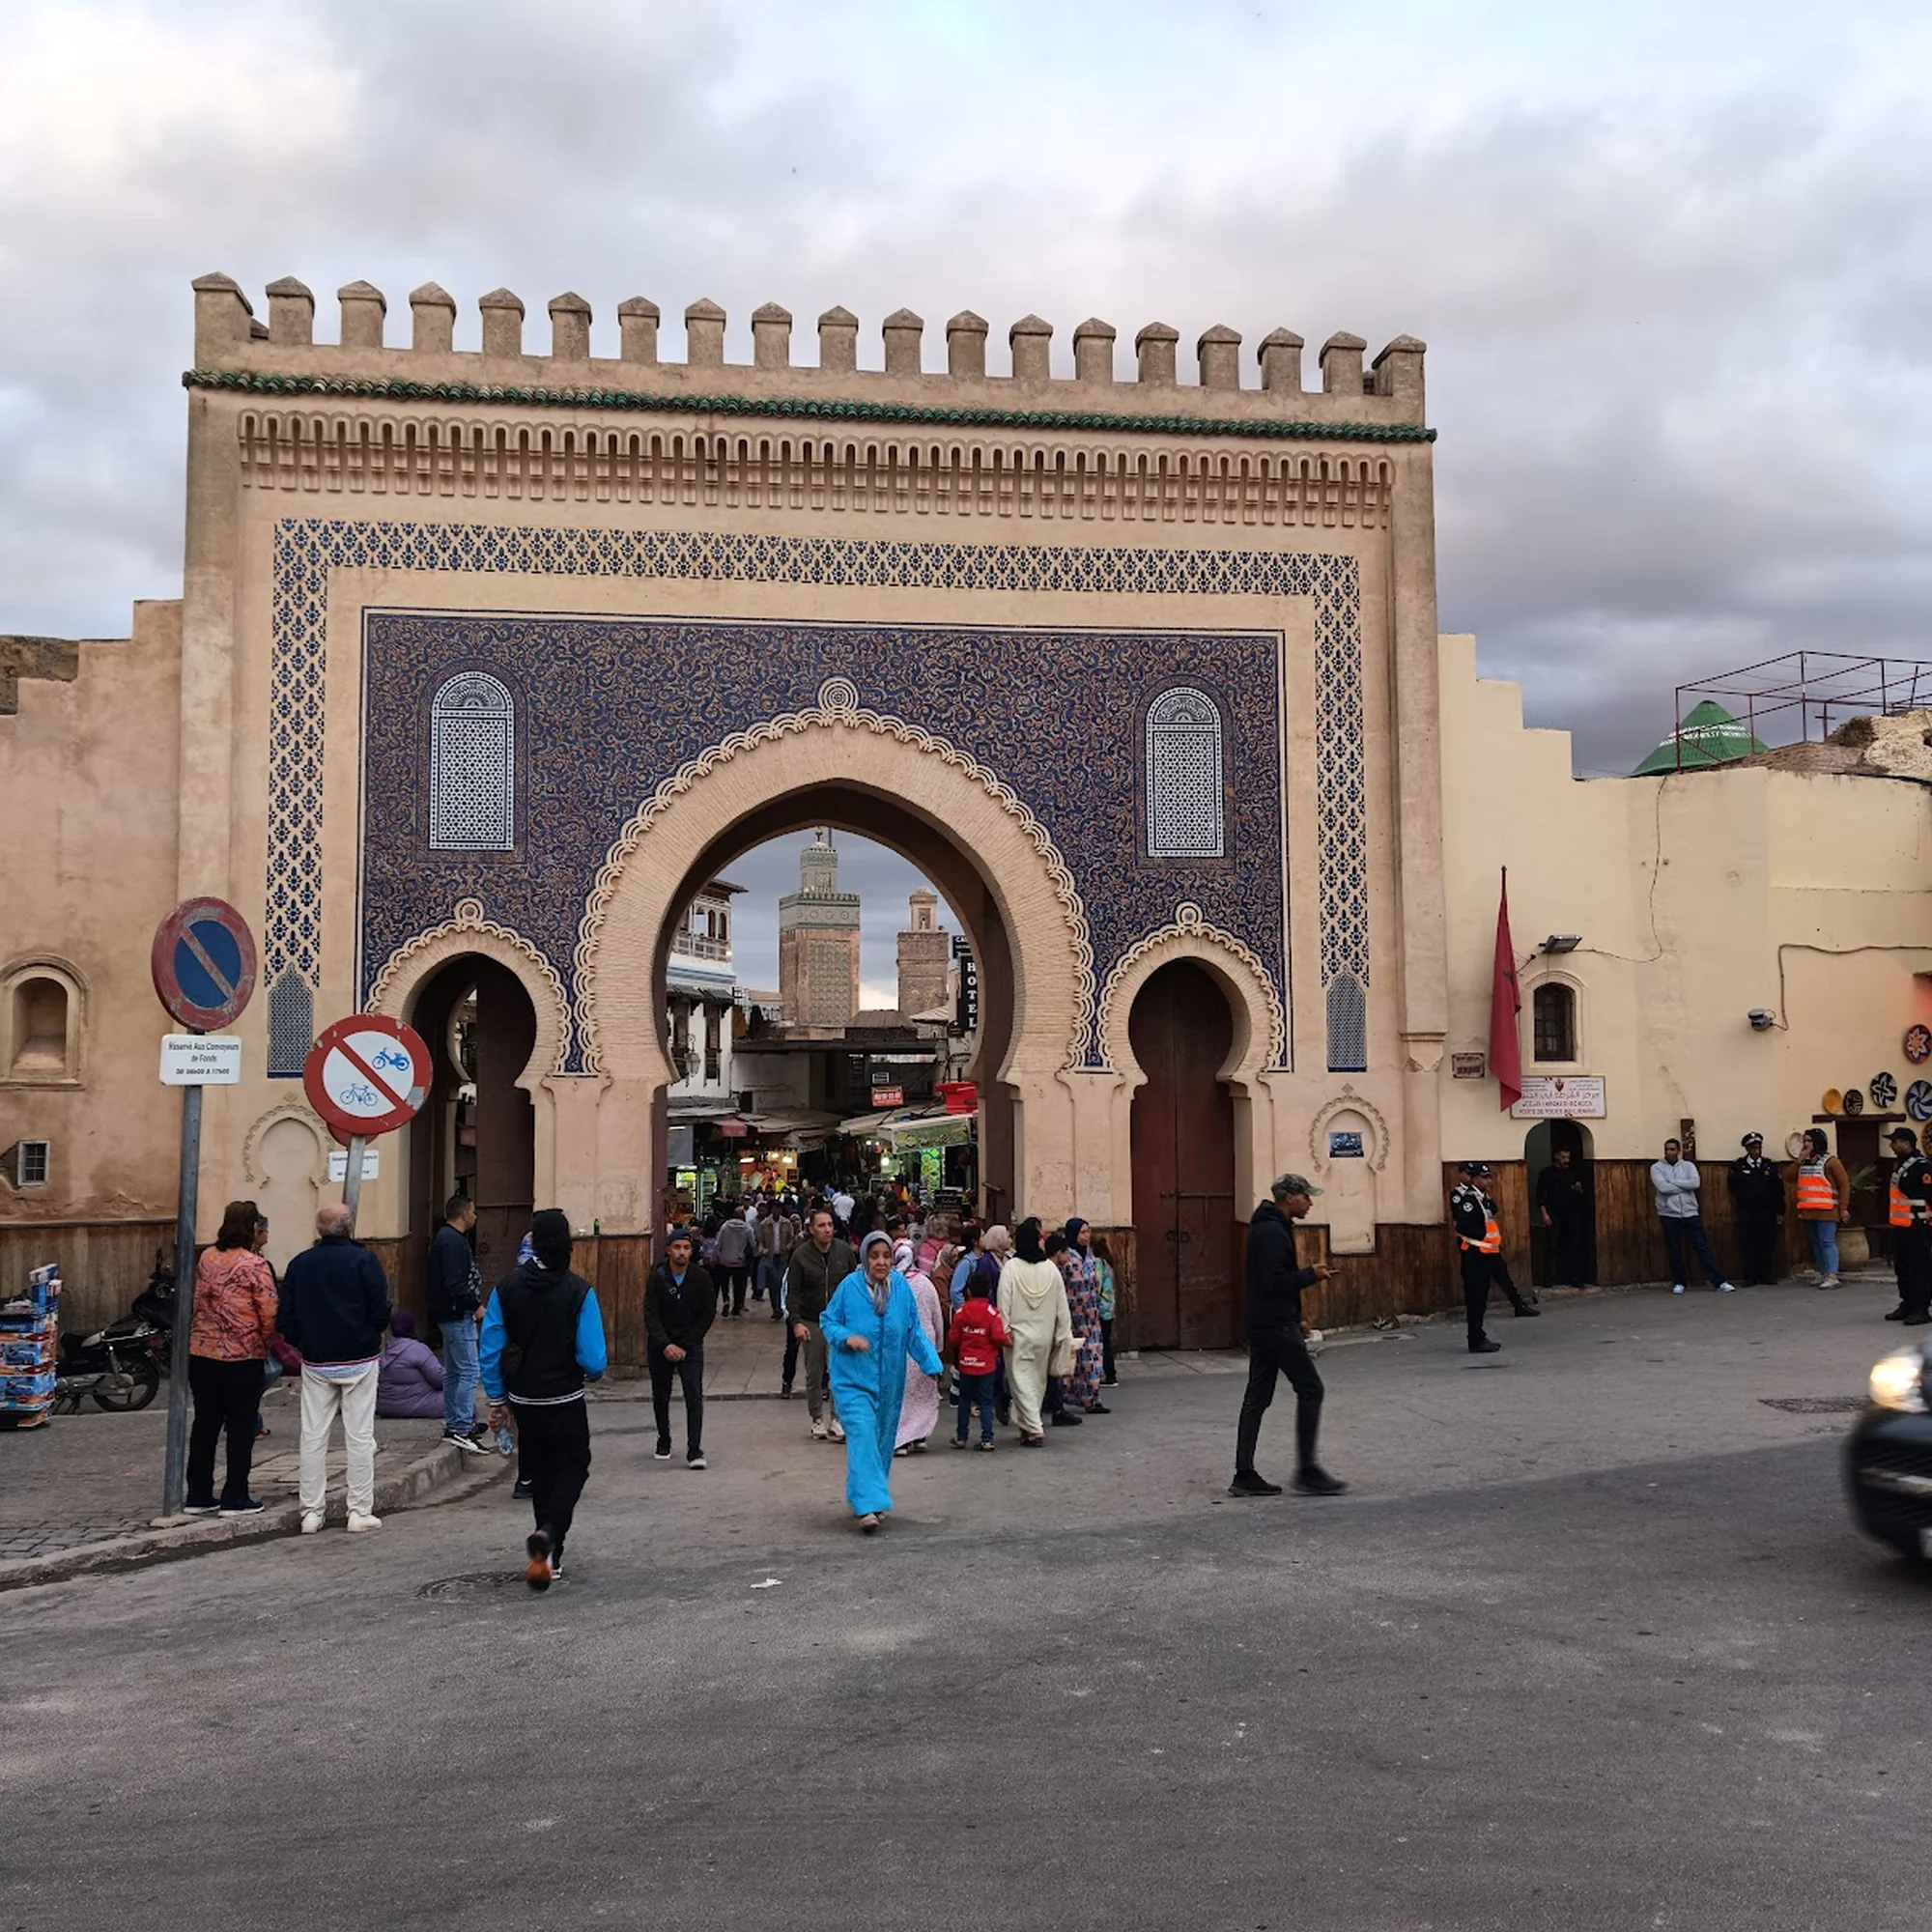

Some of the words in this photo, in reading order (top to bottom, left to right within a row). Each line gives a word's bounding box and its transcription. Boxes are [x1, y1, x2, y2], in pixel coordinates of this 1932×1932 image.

[967, 962, 978, 1028] HOTEL
[193, 1042, 205, 1051] Aux
[206, 1042, 240, 1053] Convoyeurs
[199, 1054, 217, 1063] Fonds
